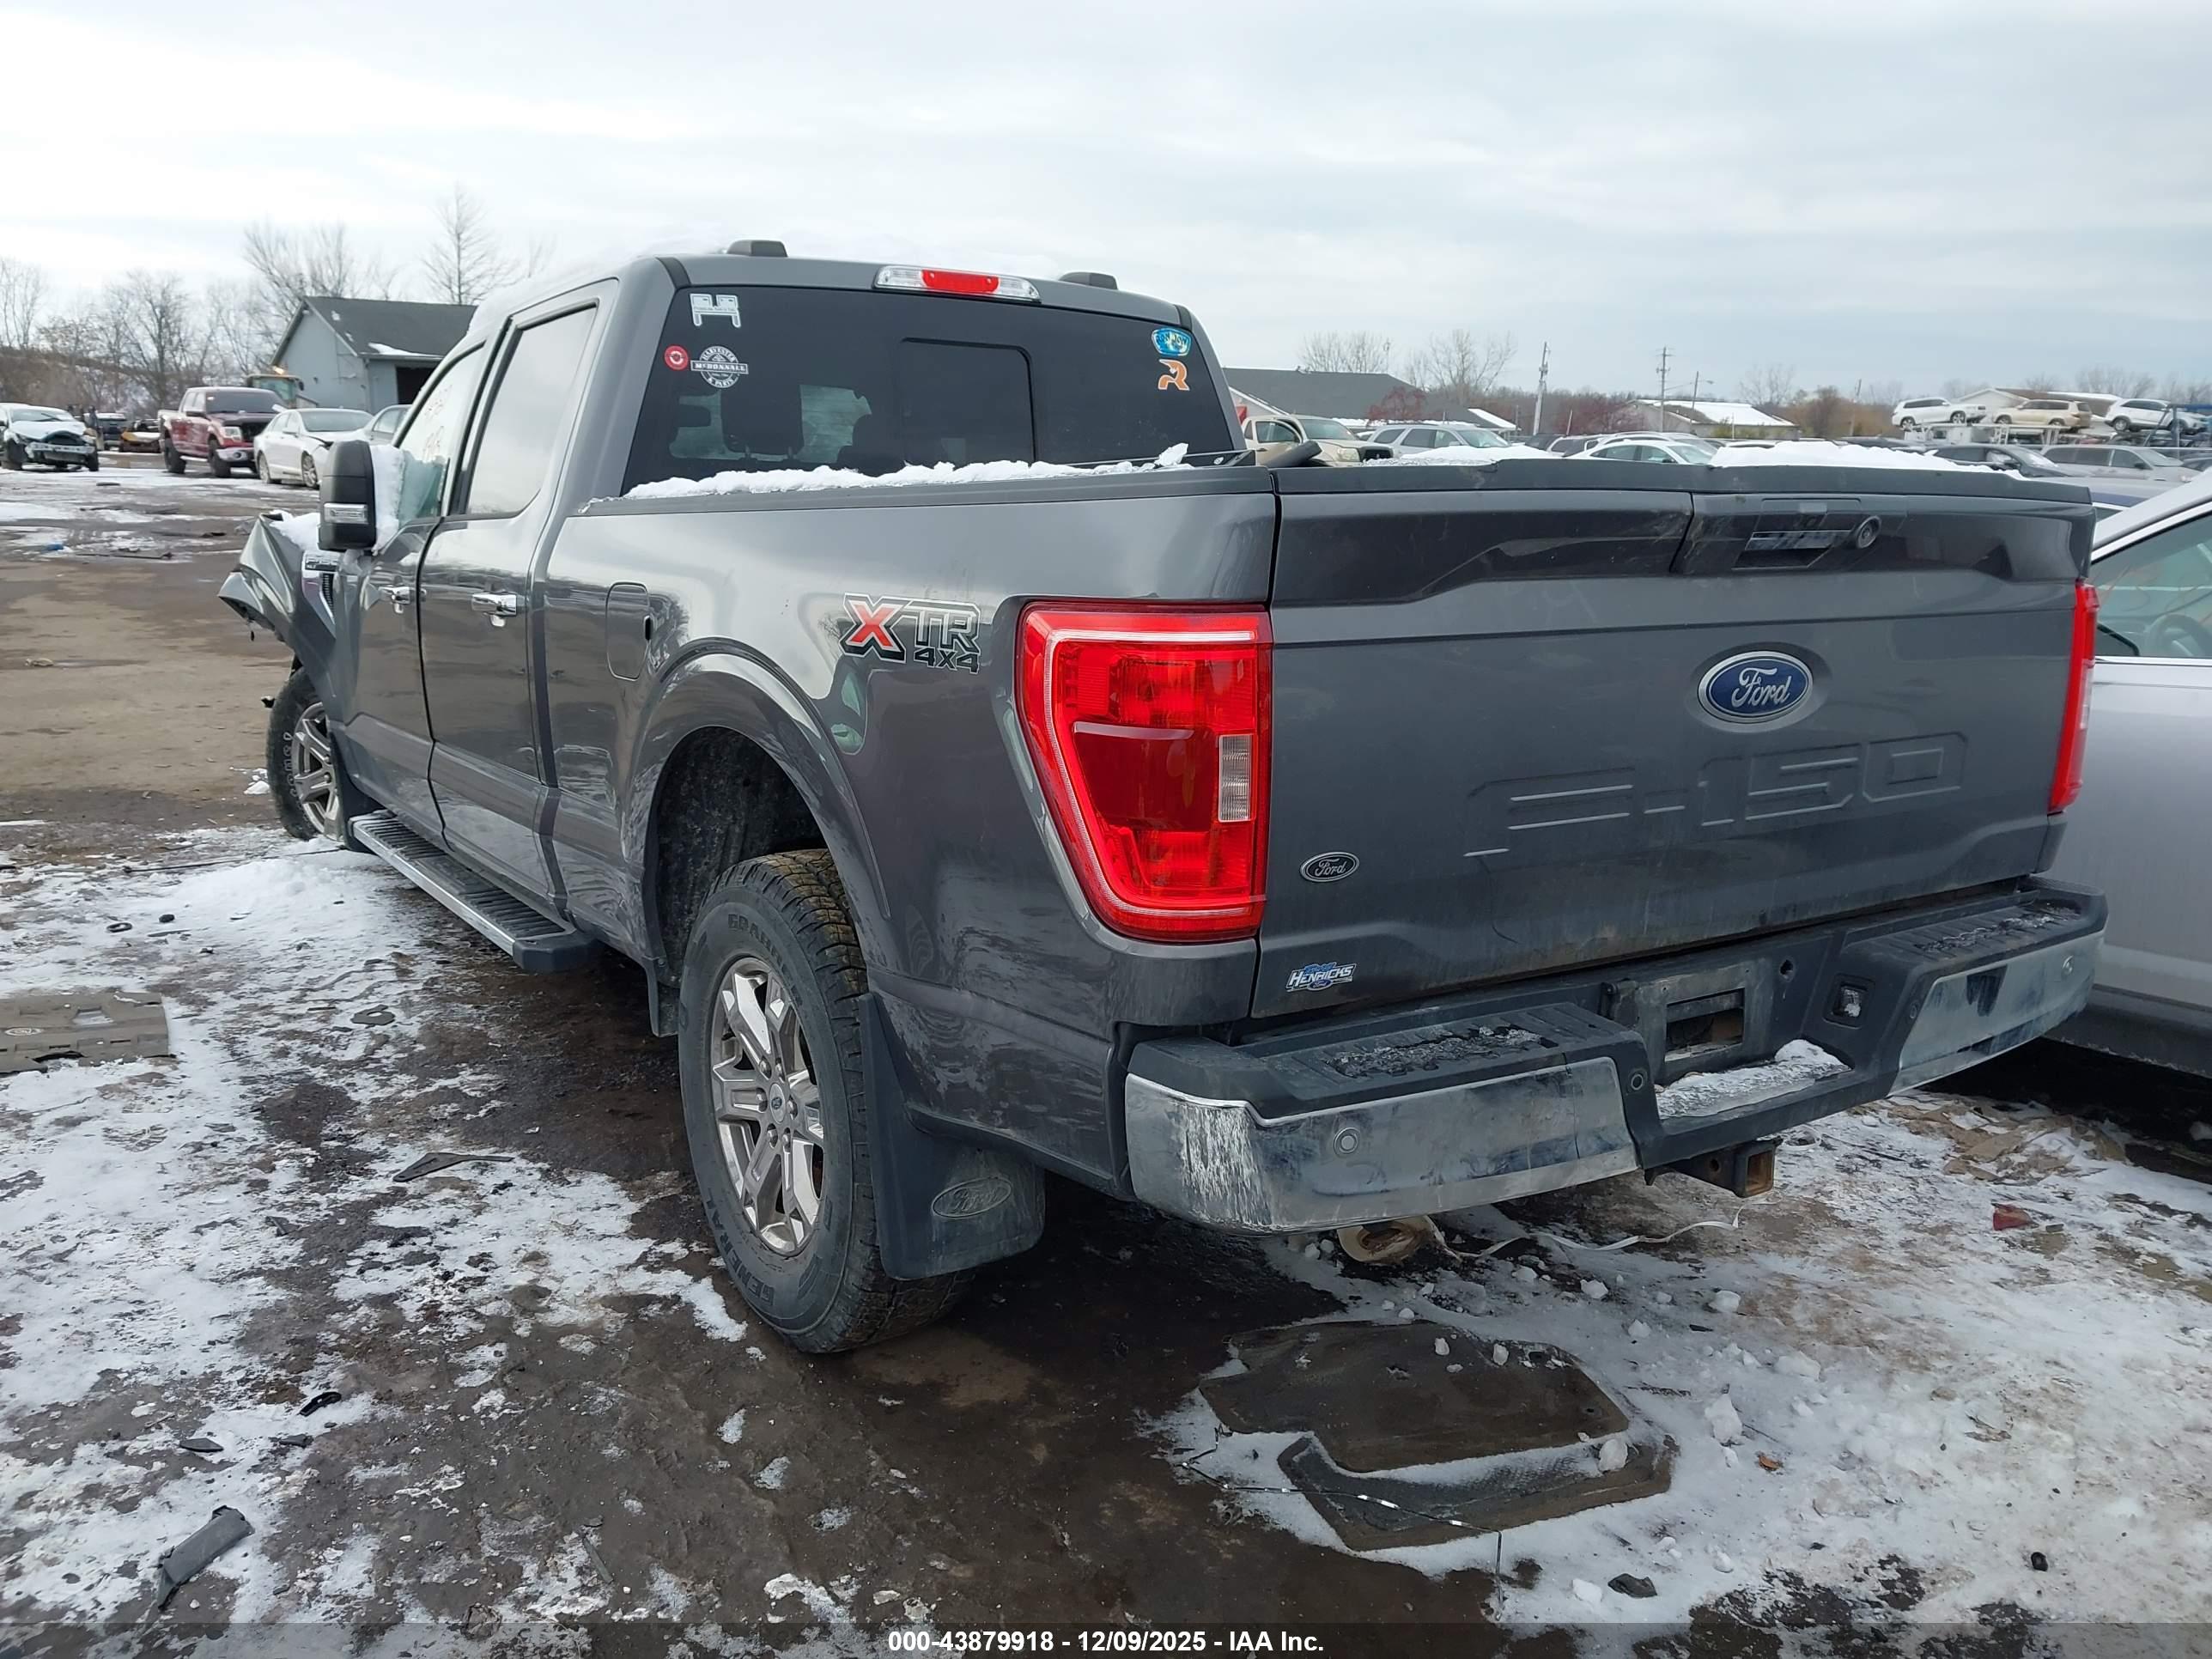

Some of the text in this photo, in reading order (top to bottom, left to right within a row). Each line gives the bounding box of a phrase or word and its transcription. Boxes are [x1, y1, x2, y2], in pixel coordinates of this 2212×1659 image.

[838, 592, 981, 664] XTR
[1731, 667, 1792, 708] Ford
[1315, 858, 1347, 877] Ford
[1289, 964, 1354, 988] HENRICKS
[706, 1187, 775, 1306] GENERAL
